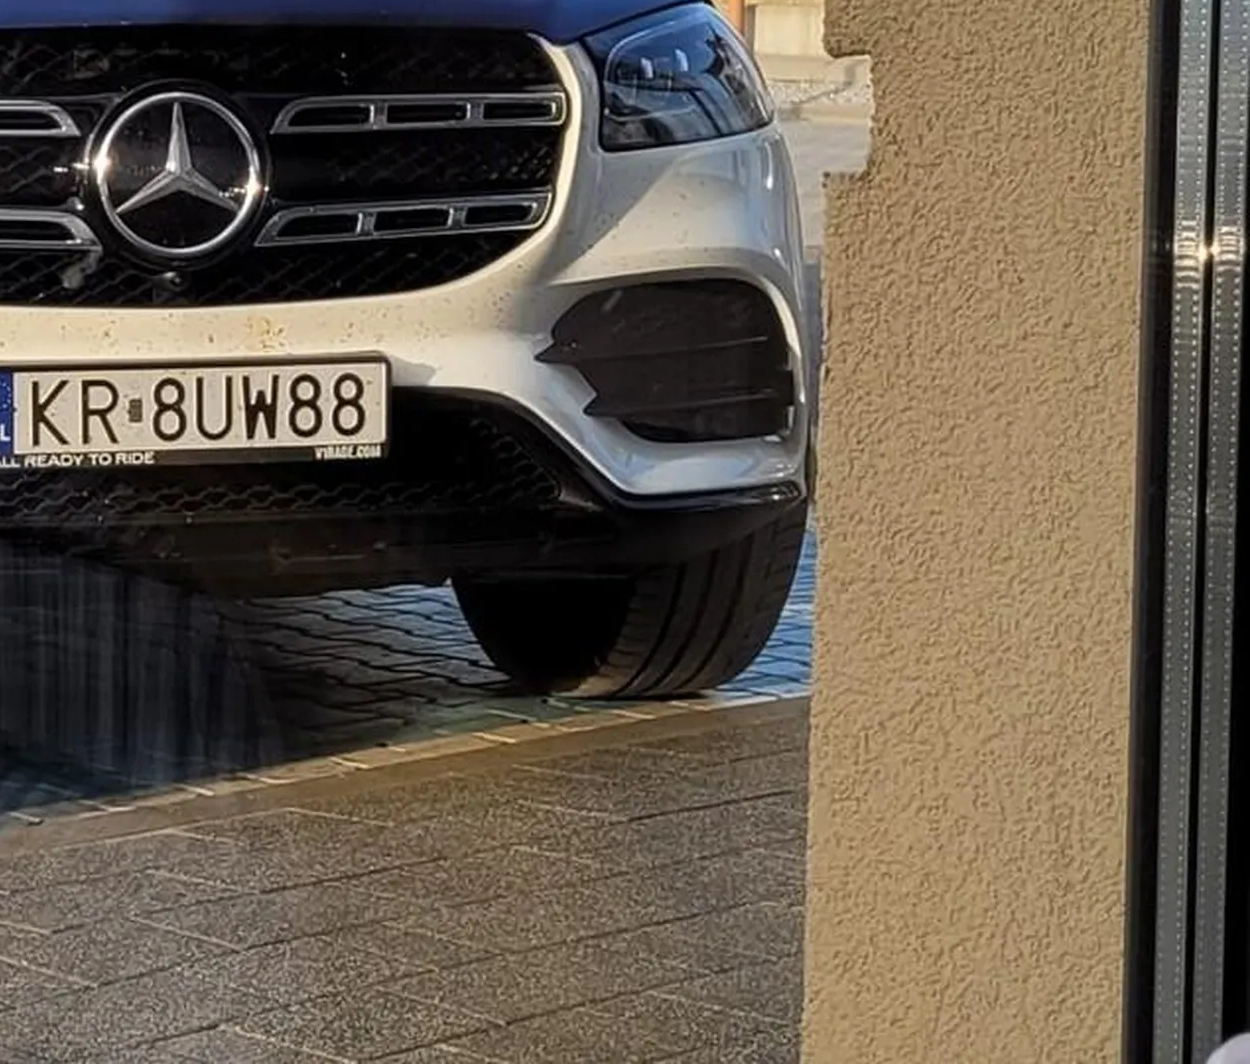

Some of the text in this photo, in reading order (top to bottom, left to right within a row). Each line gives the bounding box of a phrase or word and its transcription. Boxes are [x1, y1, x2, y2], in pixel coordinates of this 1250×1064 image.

[31, 372, 366, 447] KR 8UW88
[23, 453, 84, 469] READY
[87, 451, 113, 467] TO
[114, 449, 155, 466] RIDE
